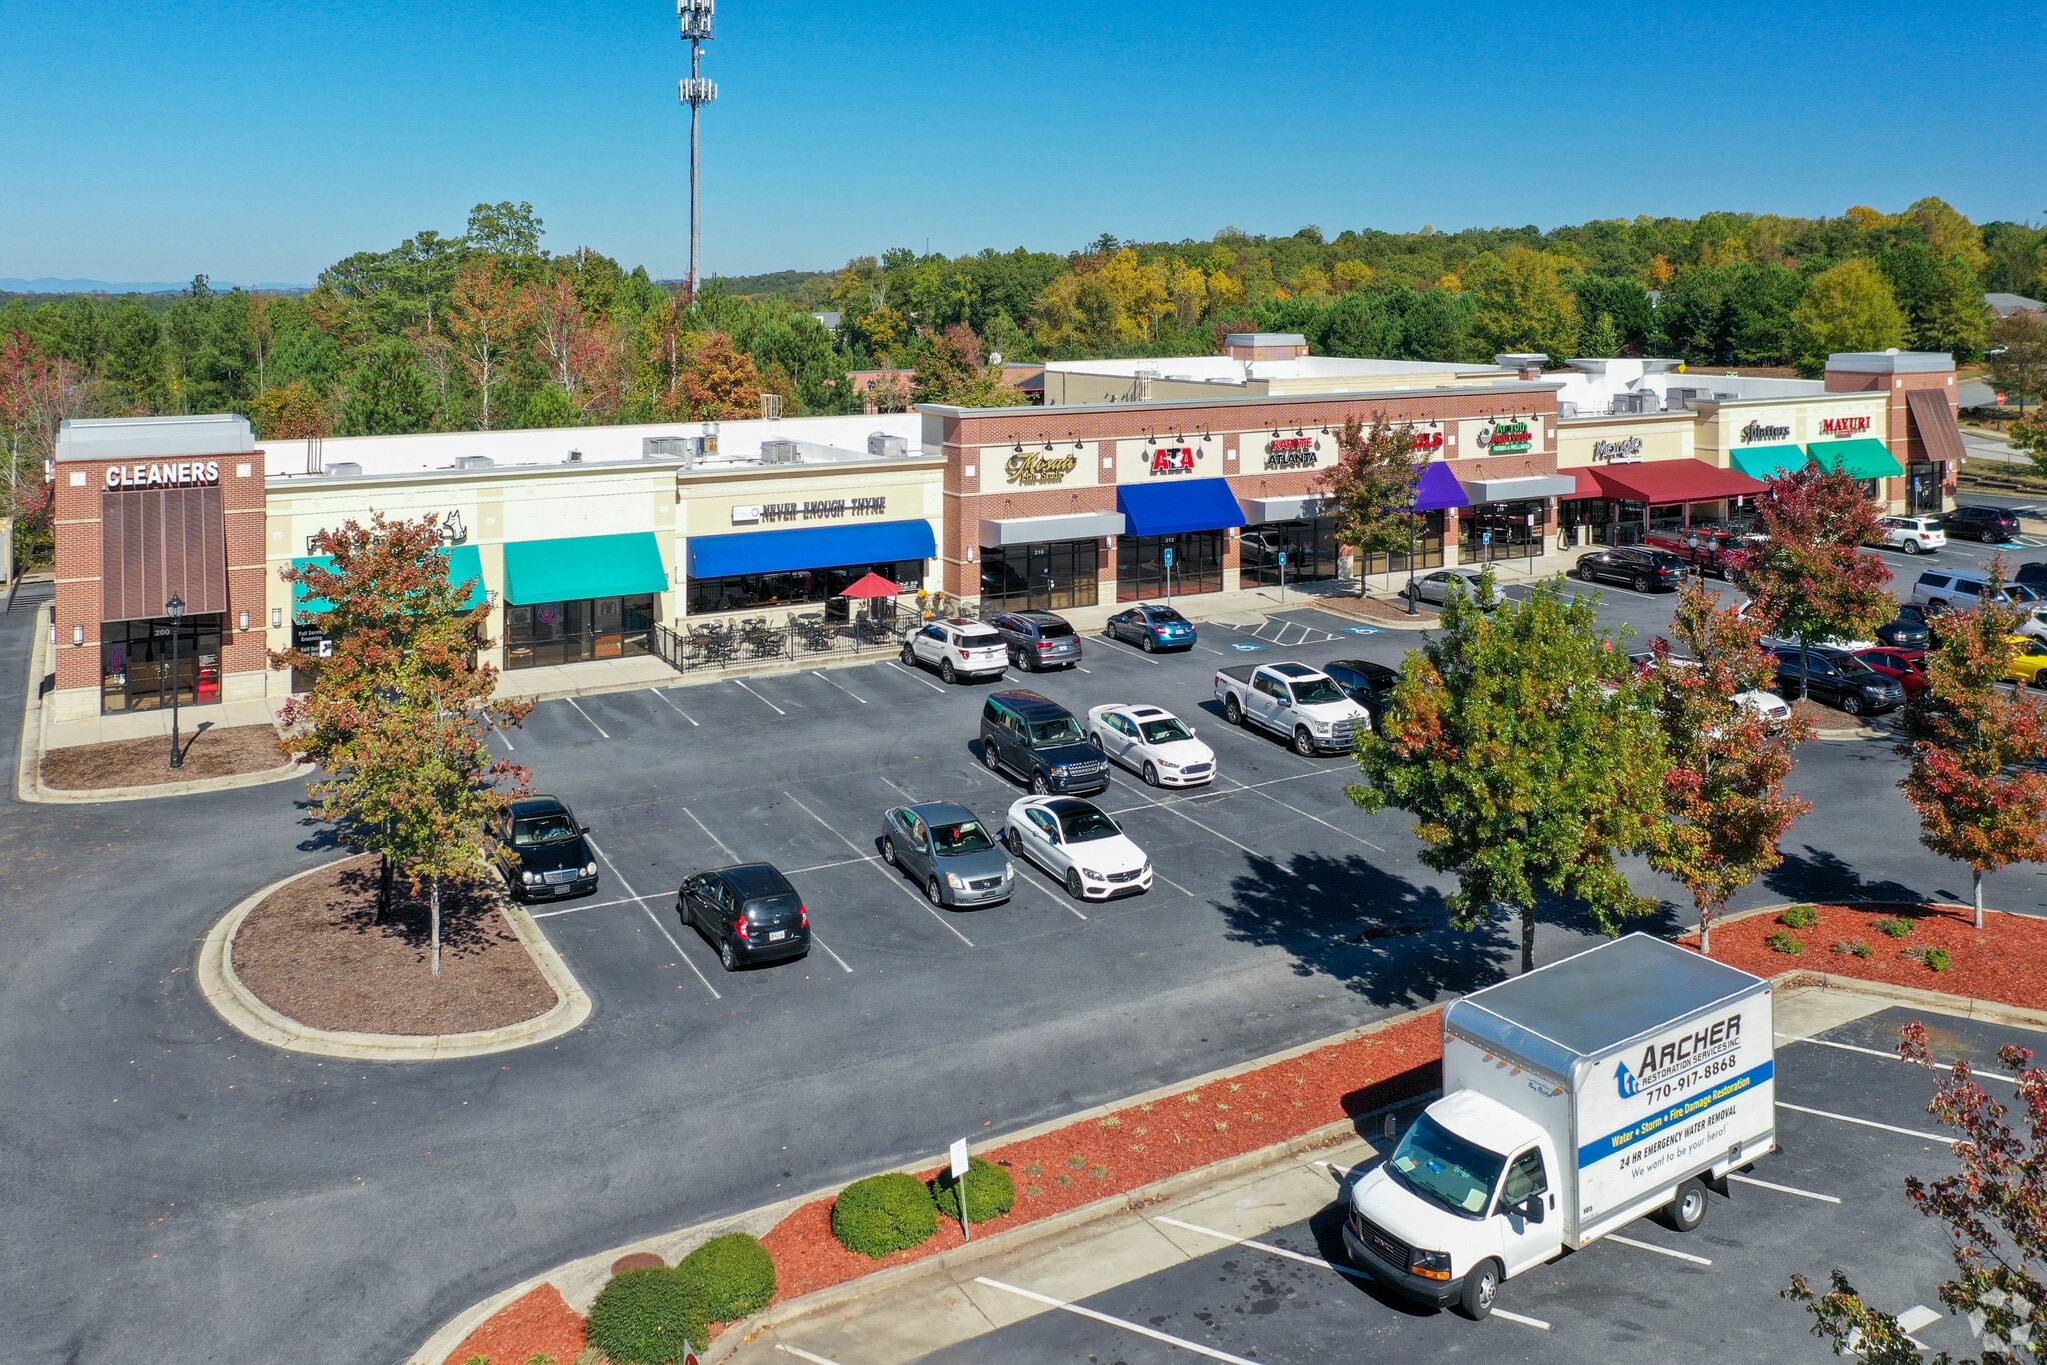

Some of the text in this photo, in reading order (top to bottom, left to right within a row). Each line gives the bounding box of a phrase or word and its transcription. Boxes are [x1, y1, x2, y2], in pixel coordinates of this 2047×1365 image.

[1743, 424, 1790, 440] Splatters
[1822, 416, 1871, 432] MAYURI
[1271, 437, 1313, 450] KARATE
[1492, 431, 1533, 445] Ayurveda
[1595, 437, 1643, 458] Mangia
[1268, 452, 1318, 465] ATLANTA
[105, 461, 220, 487] CLEANERS
[762, 503, 798, 517] NEVER
[803, 500, 845, 514] ENOUGH
[851, 497, 886, 511] THYME
[1638, 1013, 1741, 1079] ARCHER
[1643, 1058, 1691, 1087] RESTORATION
[1693, 1043, 1728, 1064] SERVICES
[1647, 1055, 1736, 1105] 770-917-8868
[1612, 1077, 1751, 1148] Water Storm Fire Damage Restoration
[1619, 1105, 1736, 1170] 24 HR EMERGENCY WATER REMOVAL
[1631, 1167, 1645, 1179] We
[1647, 1156, 1665, 1171] want
[1666, 1153, 1675, 1164] to
[1677, 1145, 1687, 1158] be
[1688, 1138, 1706, 1155] your
